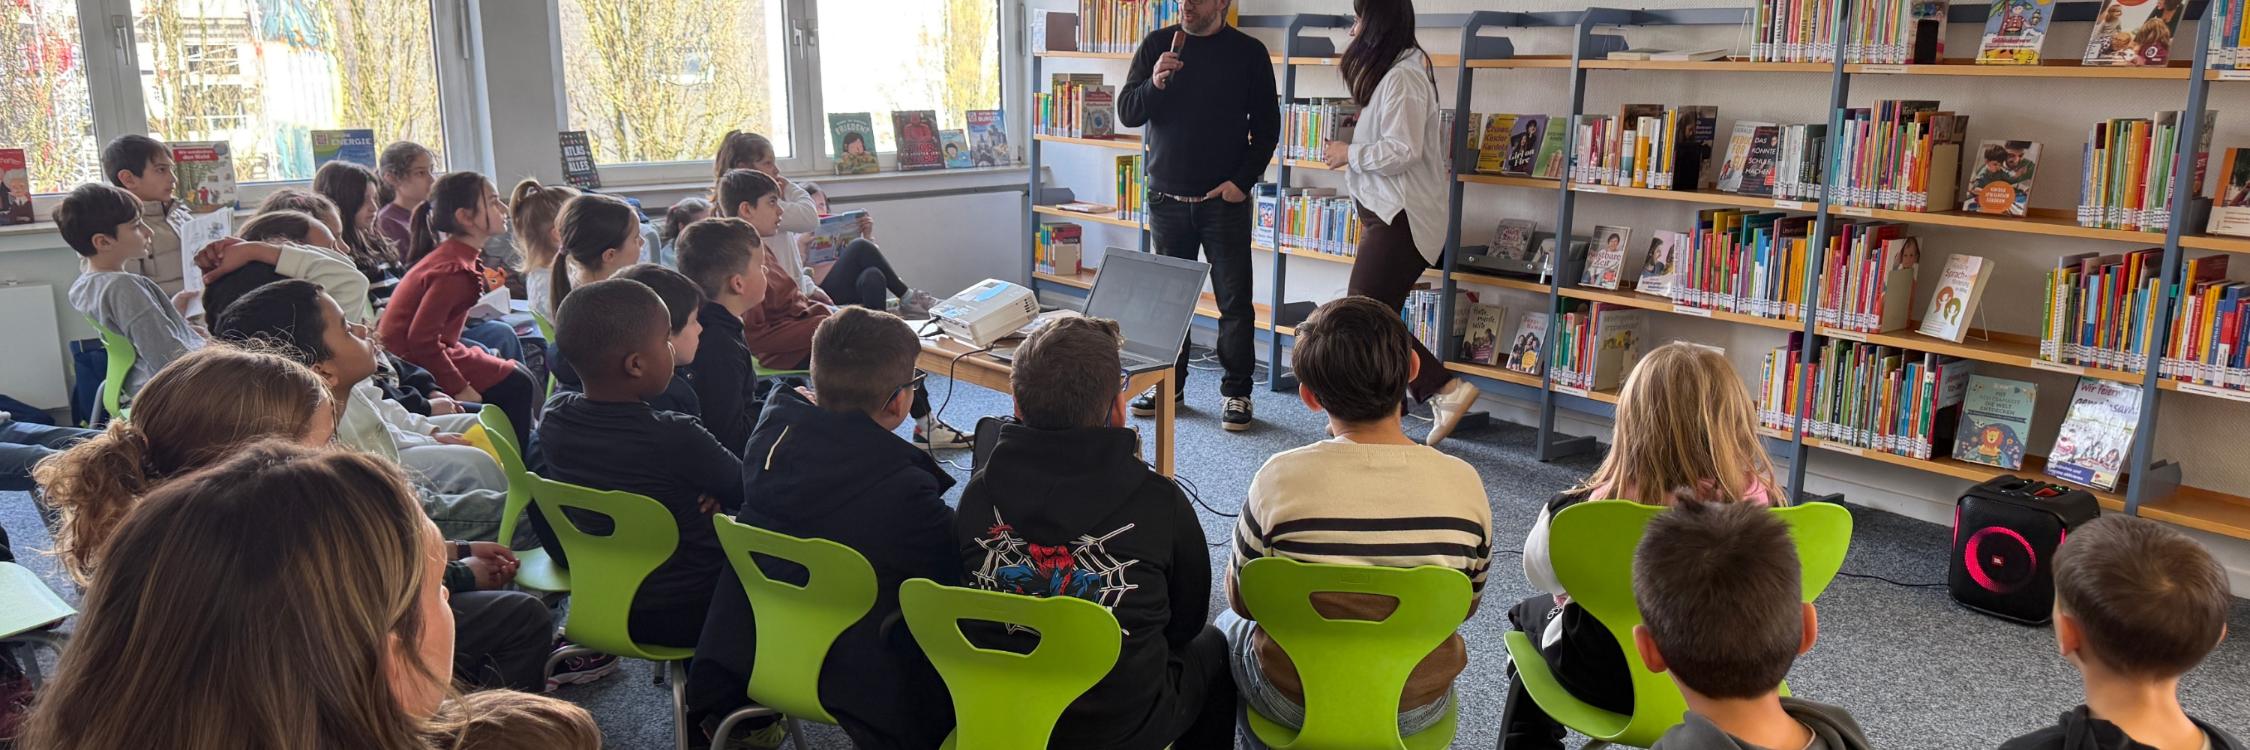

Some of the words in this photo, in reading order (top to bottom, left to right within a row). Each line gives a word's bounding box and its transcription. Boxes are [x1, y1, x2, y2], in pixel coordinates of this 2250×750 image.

[331, 137, 373, 146] ENERGIE
[564, 145, 587, 156] ATLAS
[569, 160, 591, 172] ALLES
[2081, 385, 2097, 393] Wir
